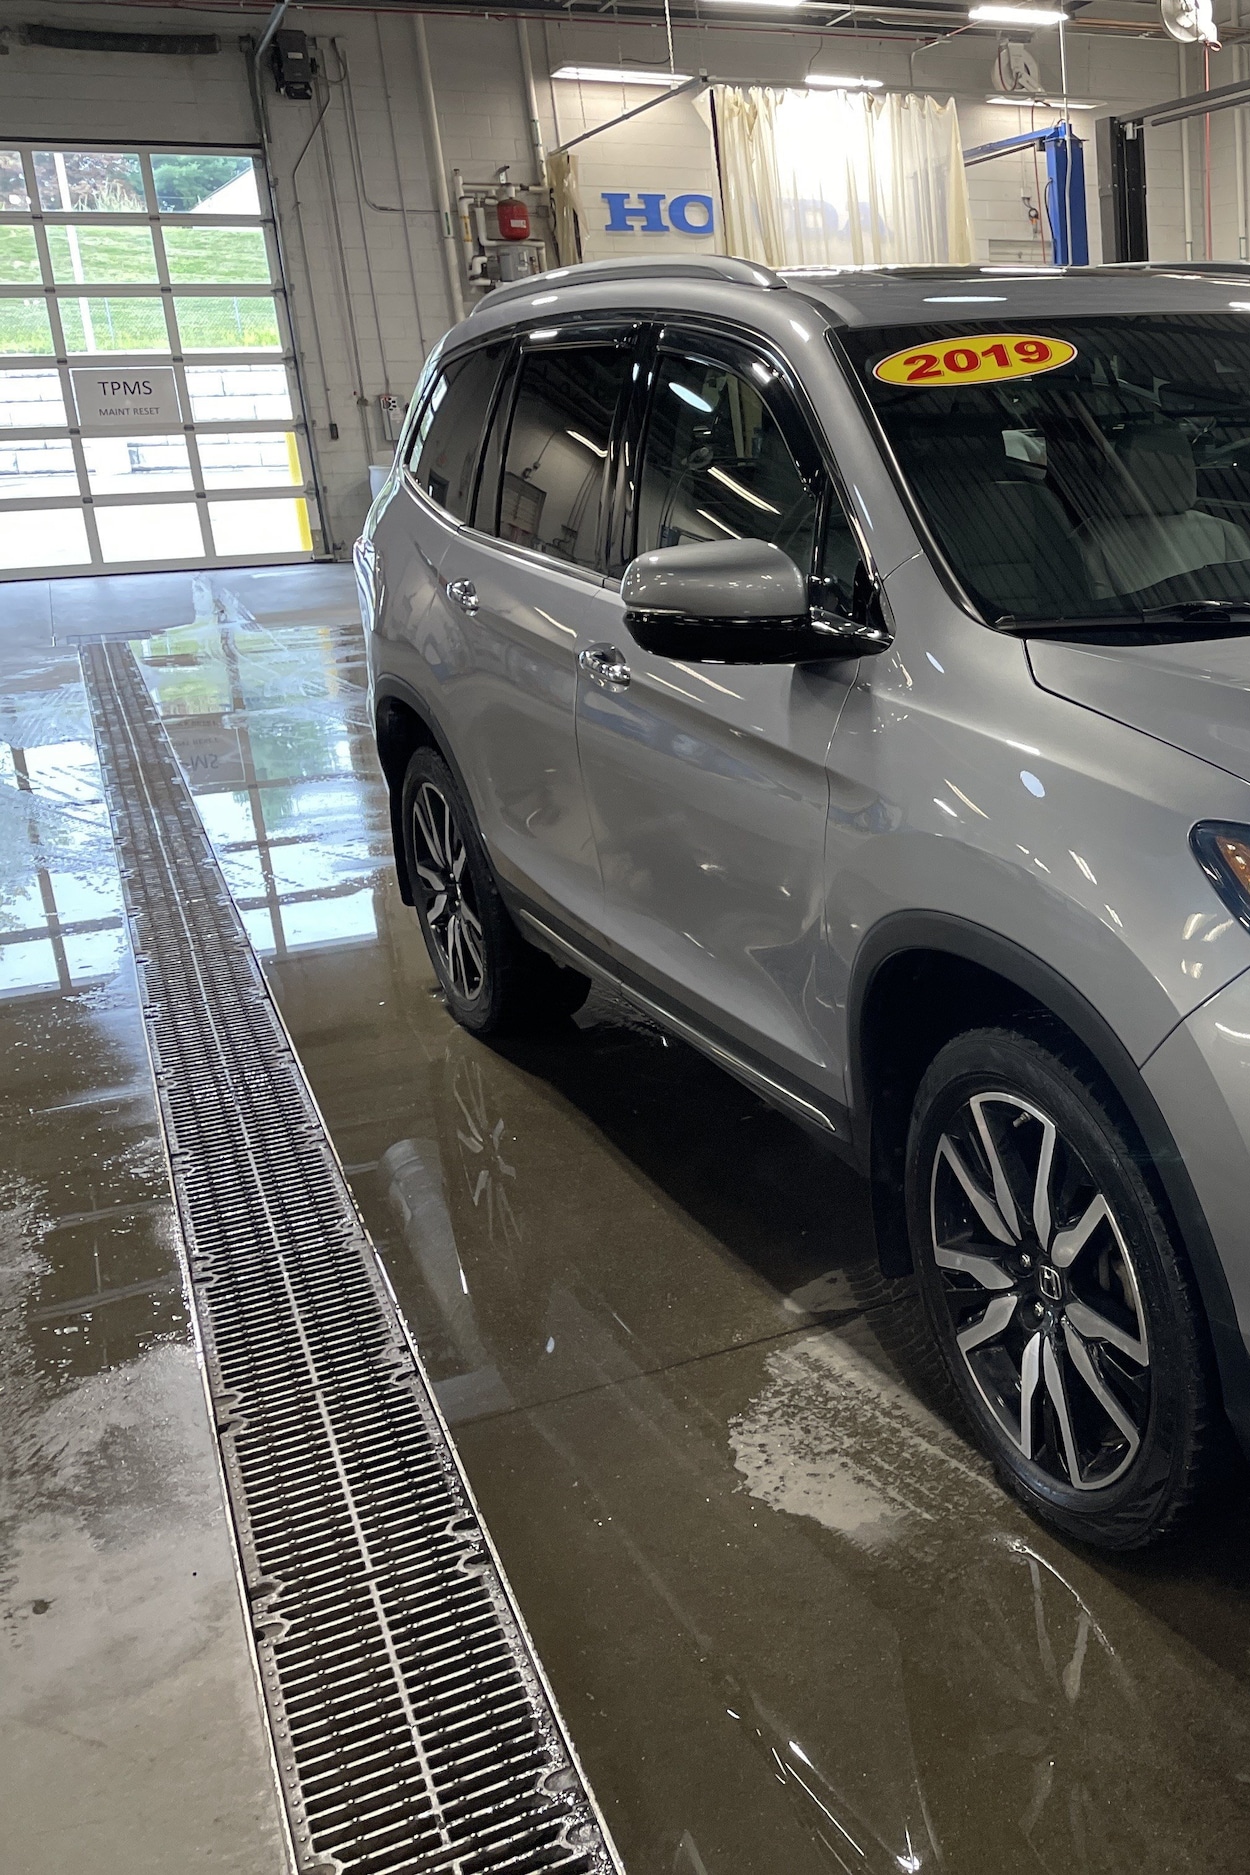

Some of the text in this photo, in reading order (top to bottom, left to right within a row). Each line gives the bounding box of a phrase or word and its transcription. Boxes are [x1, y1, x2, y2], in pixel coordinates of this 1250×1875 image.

[903, 340, 1053, 382] 2019
[97, 380, 153, 396] TPMS
[98, 406, 161, 417] MAINT RESET
